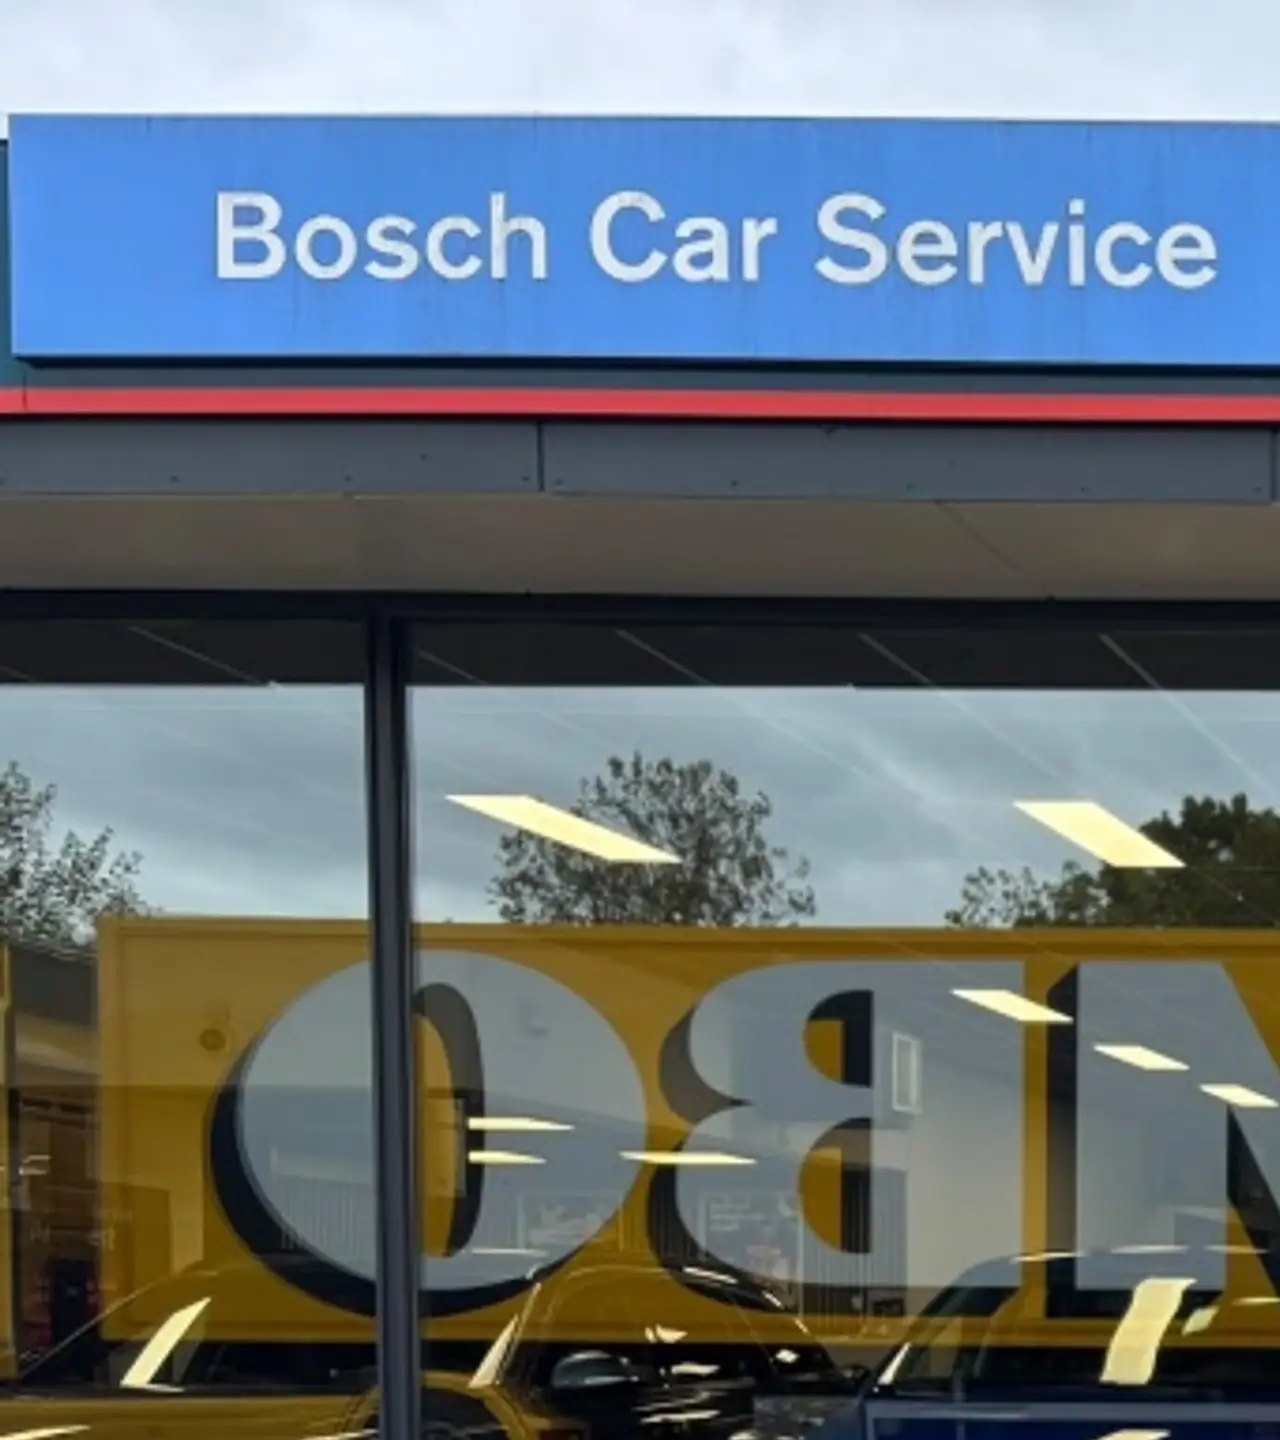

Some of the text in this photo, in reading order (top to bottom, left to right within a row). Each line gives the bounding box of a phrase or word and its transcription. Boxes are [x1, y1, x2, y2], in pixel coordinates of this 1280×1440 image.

[216, 191, 1218, 288] Bosch Car Service
